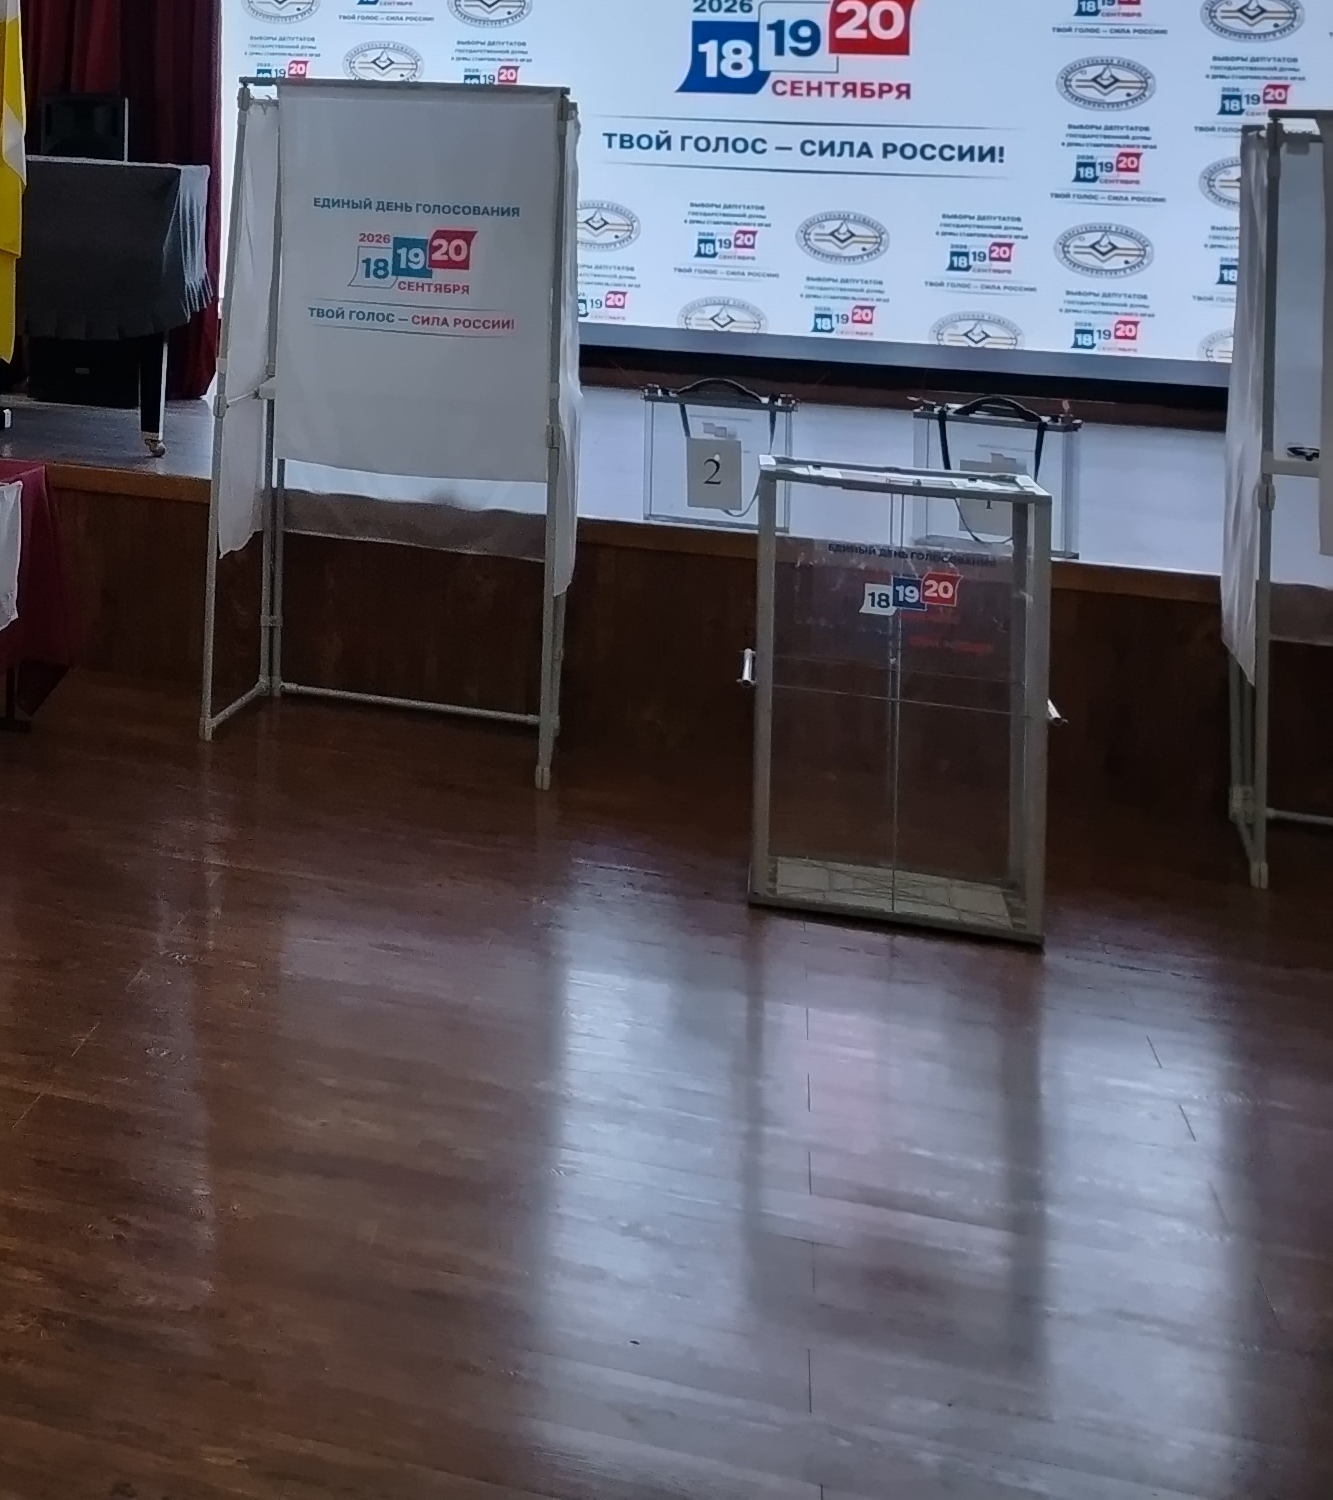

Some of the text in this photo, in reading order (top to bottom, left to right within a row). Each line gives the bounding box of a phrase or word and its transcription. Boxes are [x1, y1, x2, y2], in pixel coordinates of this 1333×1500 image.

[1079, 0, 1096, 12] 18
[697, 0, 905, 79] 18 19 20
[771, 80, 911, 100] СЕНТЯБРЯ
[1222, 89, 1286, 111] 18 19 20
[603, 131, 672, 151] ТВОЙ
[680, 136, 767, 154] ГОЛОС
[799, 140, 874, 160] СИЛА
[881, 143, 1005, 163] РОССИИ!
[1077, 157, 1138, 178] 18 19 20
[313, 197, 520, 217] ЕДИНЫЙ ДЕНЬ ГОЛОСОВАНИЯ
[359, 233, 390, 244] 2026
[699, 234, 753, 254] 18 19 20
[362, 239, 468, 279] 18 19 20
[951, 246, 1010, 267] 18 19 20
[398, 281, 470, 295] СЕНТЯБРЯ
[308, 307, 345, 319] ТВОЙ
[349, 310, 395, 323] ГОЛОС
[412, 315, 449, 327] СИЛА
[453, 317, 515, 329] РОССИИ!
[703, 458, 721, 485] 2
[868, 580, 953, 608] 18 19 20
